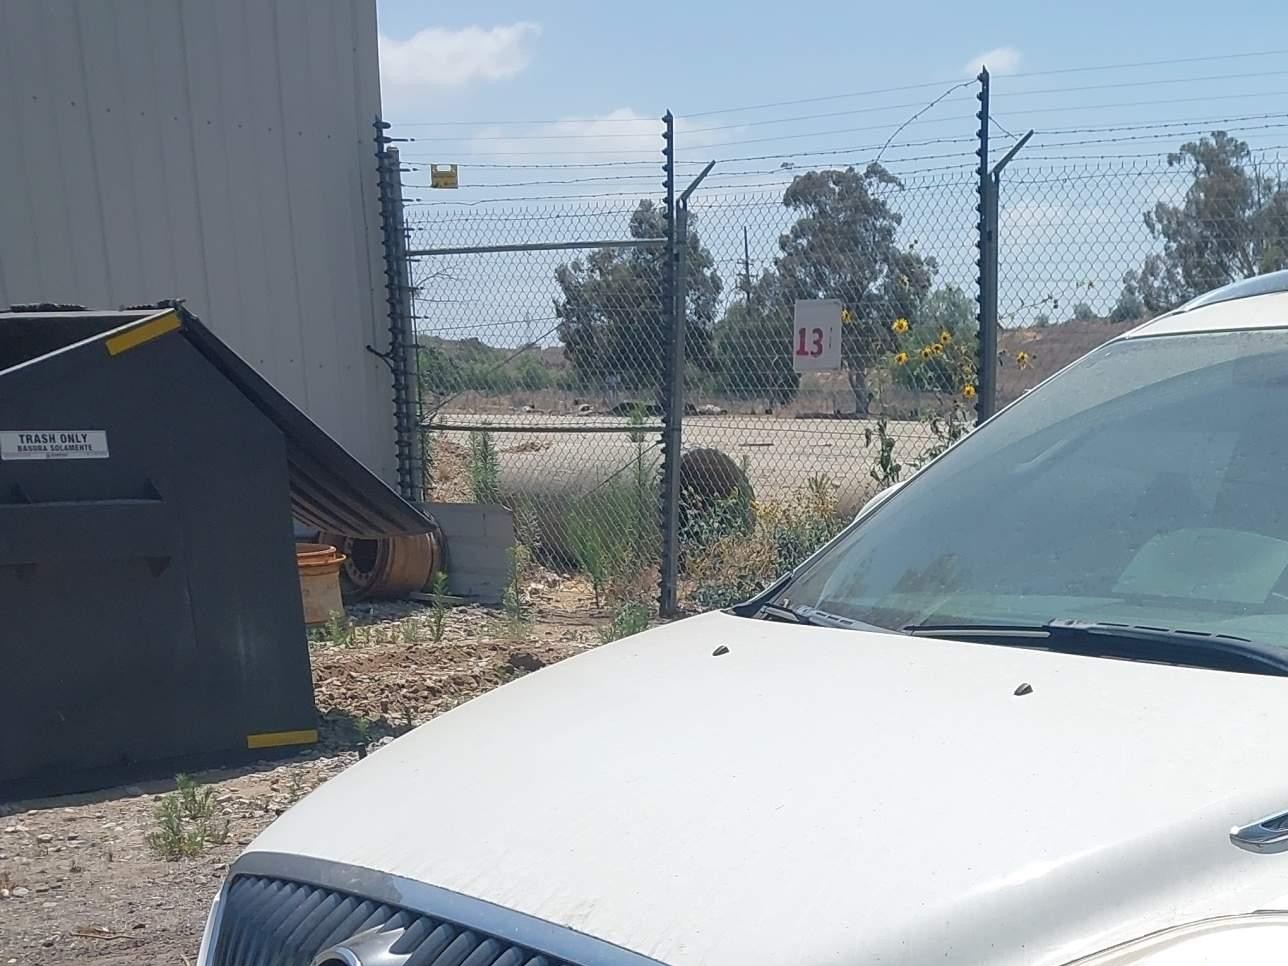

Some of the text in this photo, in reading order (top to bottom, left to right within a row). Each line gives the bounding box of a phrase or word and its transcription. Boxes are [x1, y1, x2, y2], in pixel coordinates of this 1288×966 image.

[796, 327, 824, 358] 13
[18, 433, 88, 444] TRASH ONLY
